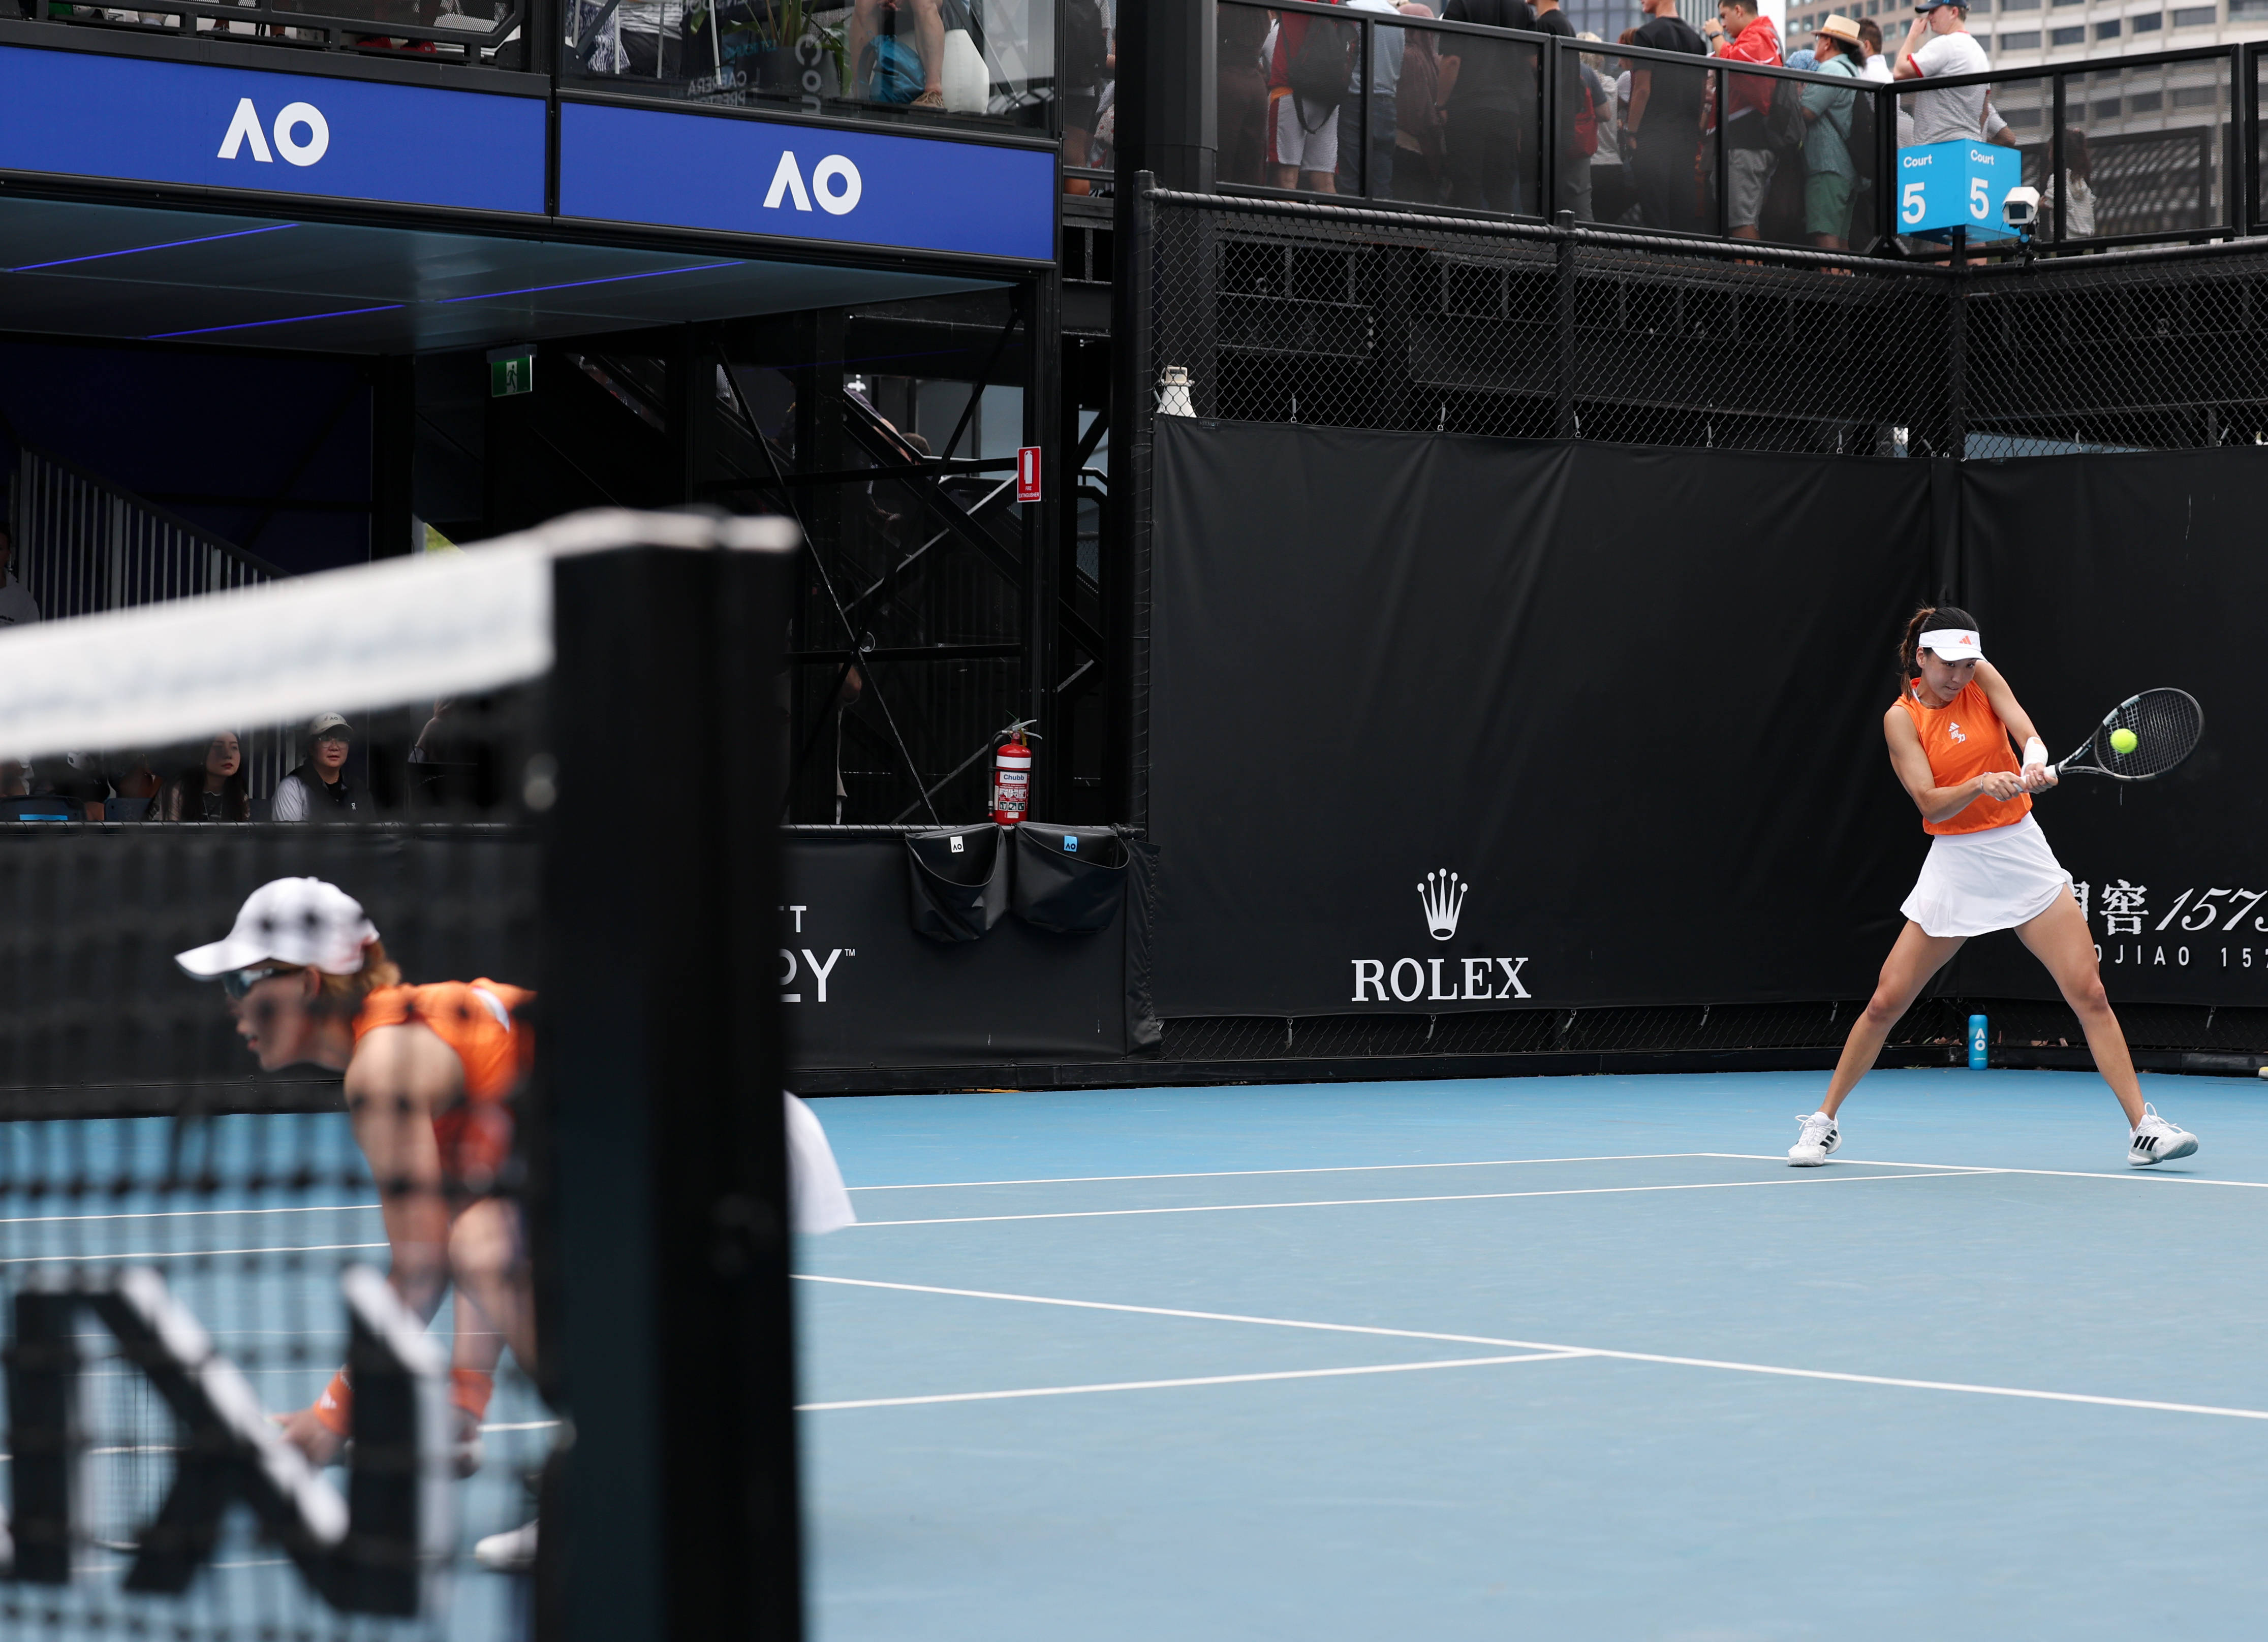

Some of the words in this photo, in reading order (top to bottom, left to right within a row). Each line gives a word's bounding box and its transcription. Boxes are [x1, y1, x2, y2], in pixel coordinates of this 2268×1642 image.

[218, 98, 329, 166] AO
[1904, 154, 1932, 168] Court
[1971, 149, 1994, 165] Court
[763, 151, 861, 215] AO
[1902, 182, 1926, 224] 5
[1970, 177, 1990, 219] 5
[2094, 944, 2190, 966] OJIAO
[2221, 947, 2268, 969] 15
[1351, 957, 1532, 1002] ROLEX
